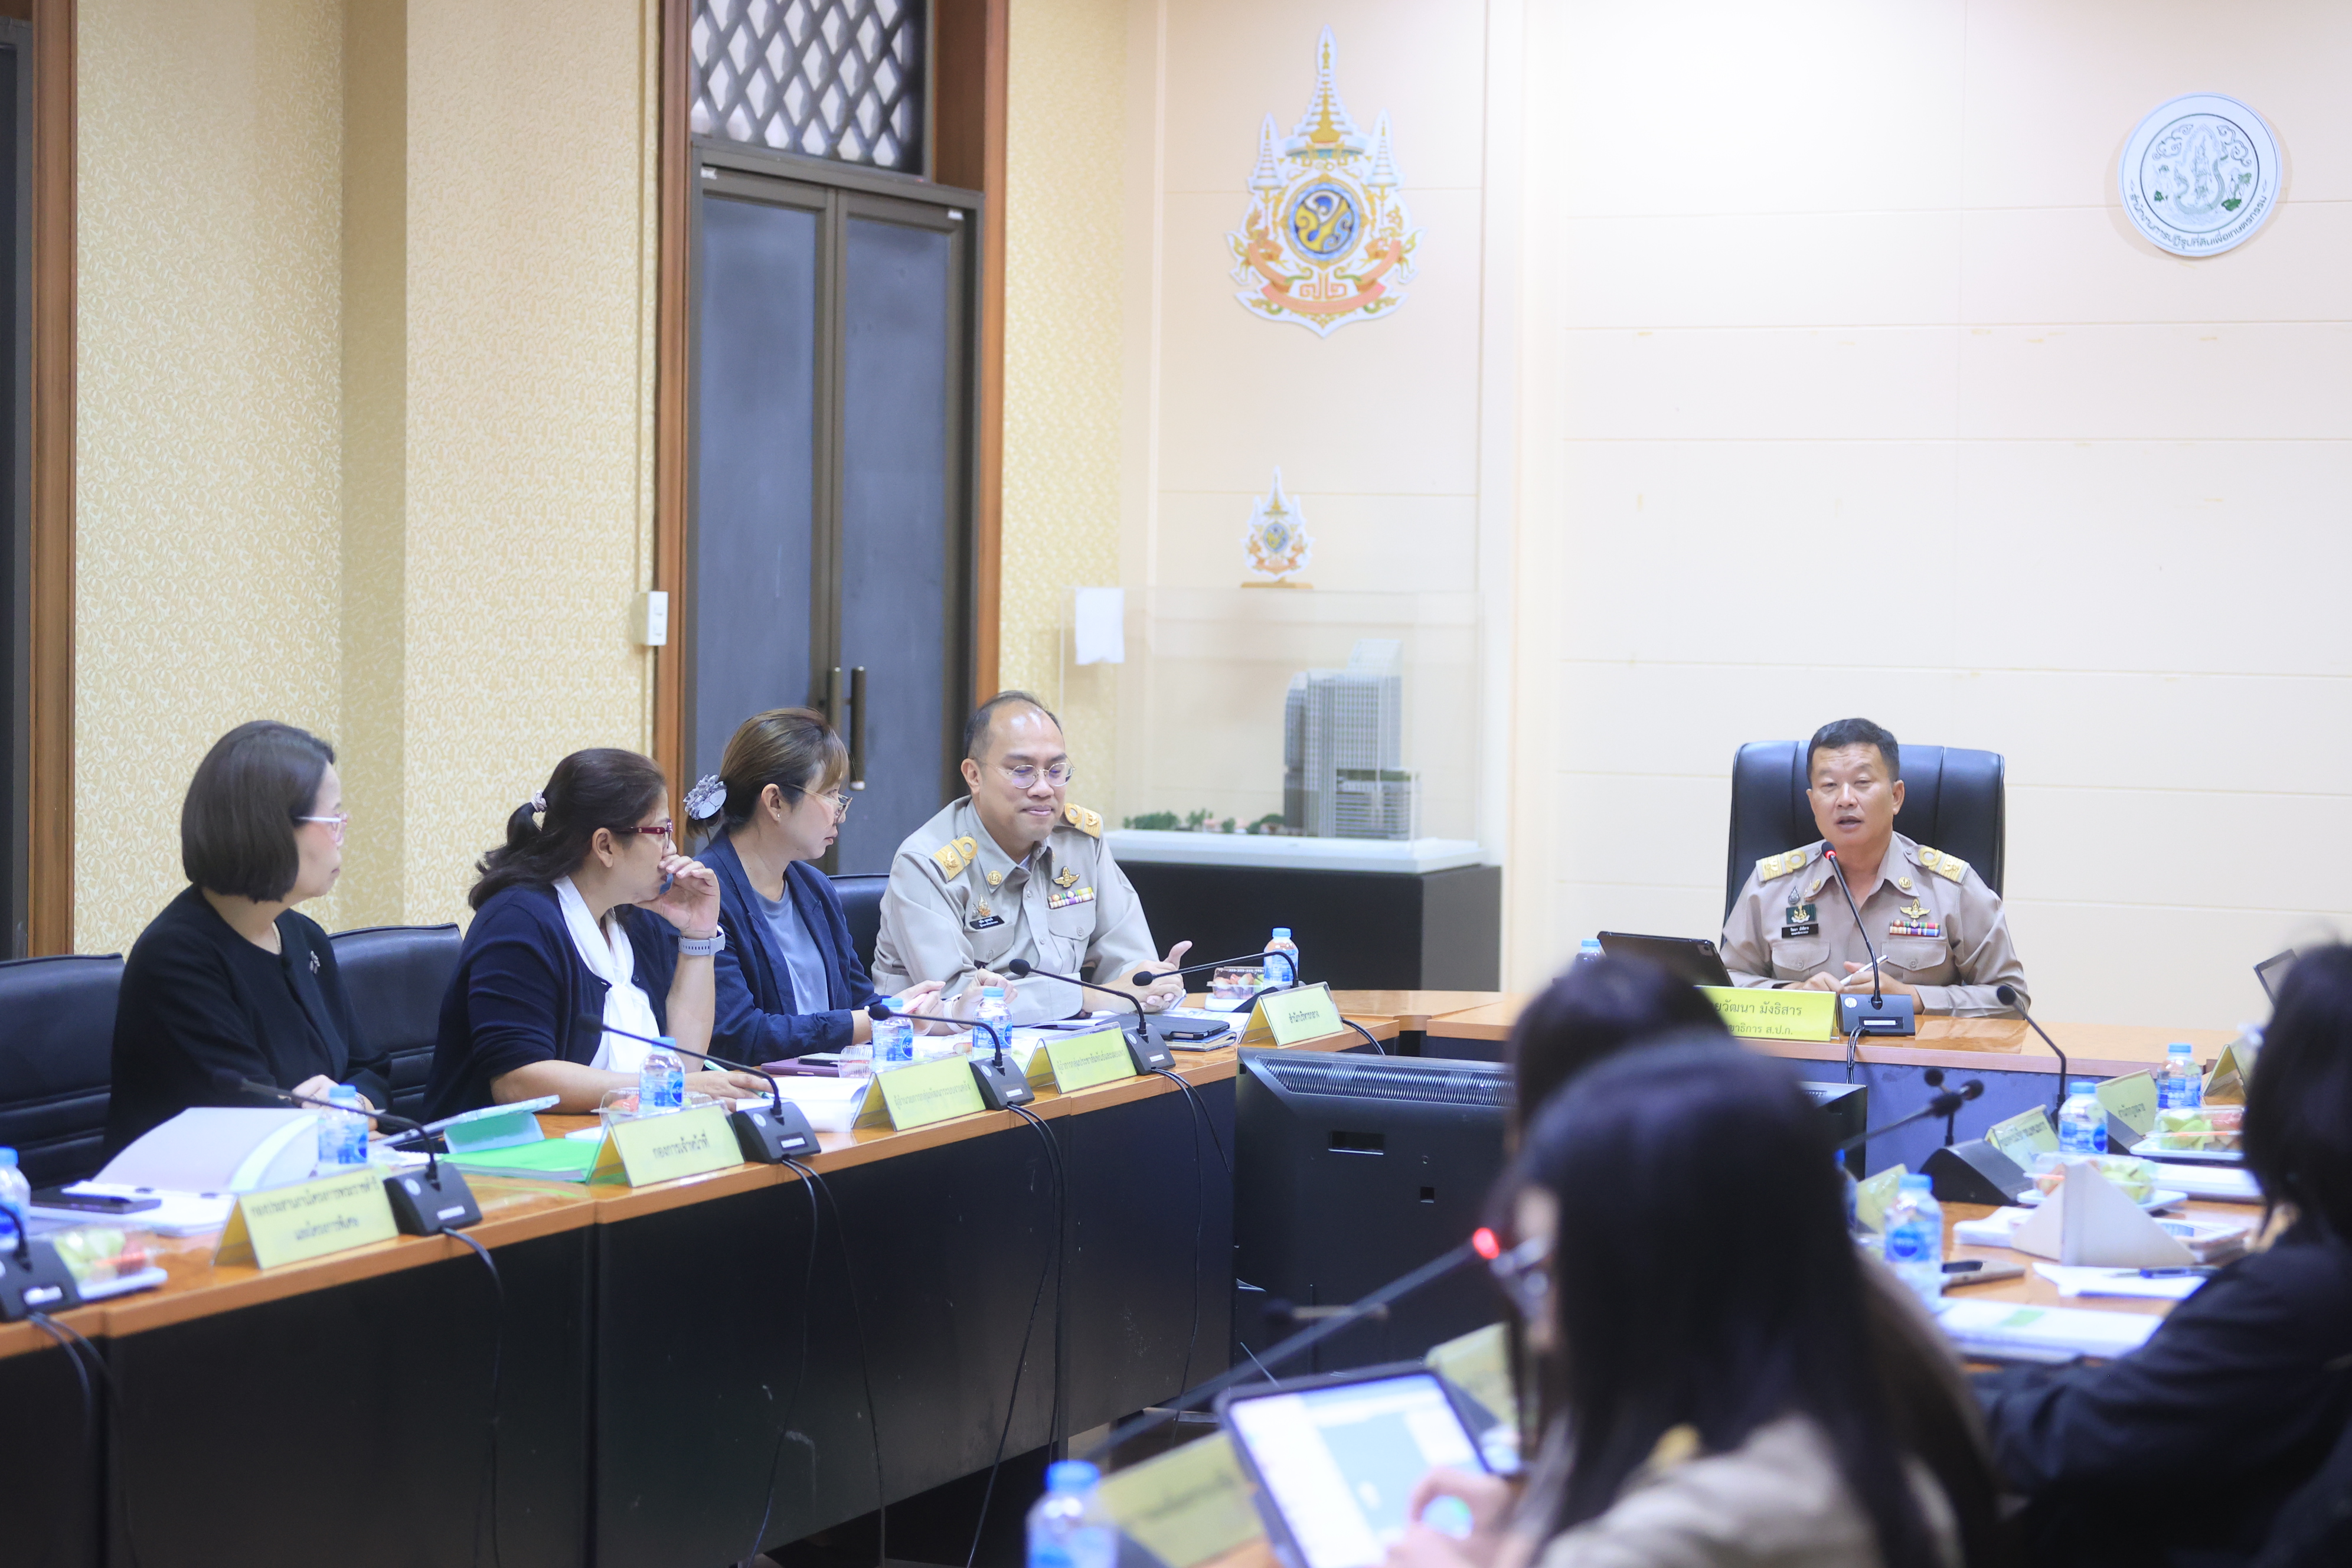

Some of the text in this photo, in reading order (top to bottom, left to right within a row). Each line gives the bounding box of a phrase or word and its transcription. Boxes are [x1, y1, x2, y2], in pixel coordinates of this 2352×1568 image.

[1714, 999, 1802, 1016] ยวัฒนา มังธิสาร
[1729, 1023, 1794, 1035] ขาธิการ ส.ป.ก.
